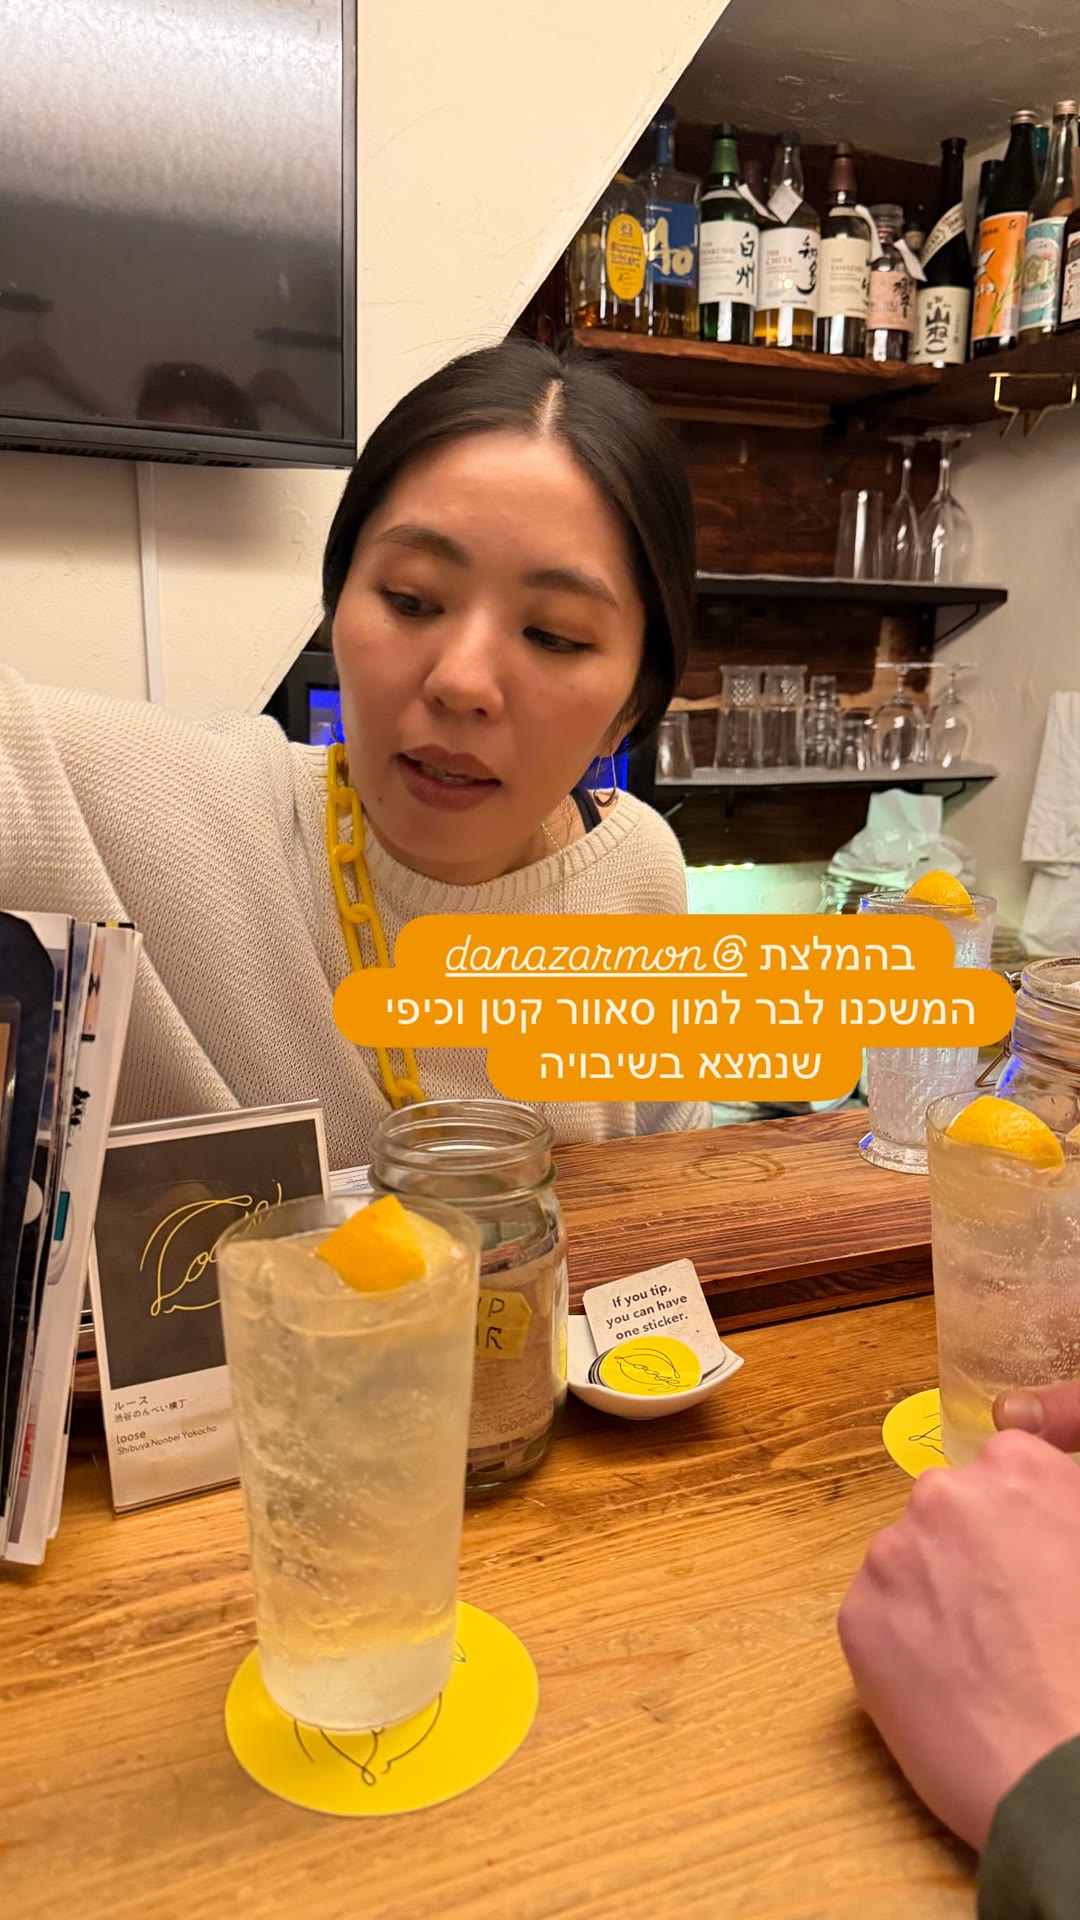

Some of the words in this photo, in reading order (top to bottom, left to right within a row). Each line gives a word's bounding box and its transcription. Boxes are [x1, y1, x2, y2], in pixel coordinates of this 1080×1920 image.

[647, 216, 694, 277] Ao
[735, 231, 755, 295] 白州
[612, 1296, 622, 1308] If
[624, 1291, 648, 1307] you
[650, 1284, 671, 1296] tip,
[606, 1313, 630, 1329] you
[633, 1306, 655, 1318] can
[656, 1295, 688, 1311] have
[616, 1327, 640, 1340] one
[643, 1313, 688, 1332] sticker.
[114, 1395, 149, 1411] ルース
[116, 1431, 146, 1445] loose
[117, 1442, 150, 1455] Shibuya
[151, 1434, 181, 1446] Nonbei
[181, 1425, 218, 1439] Yokocho
